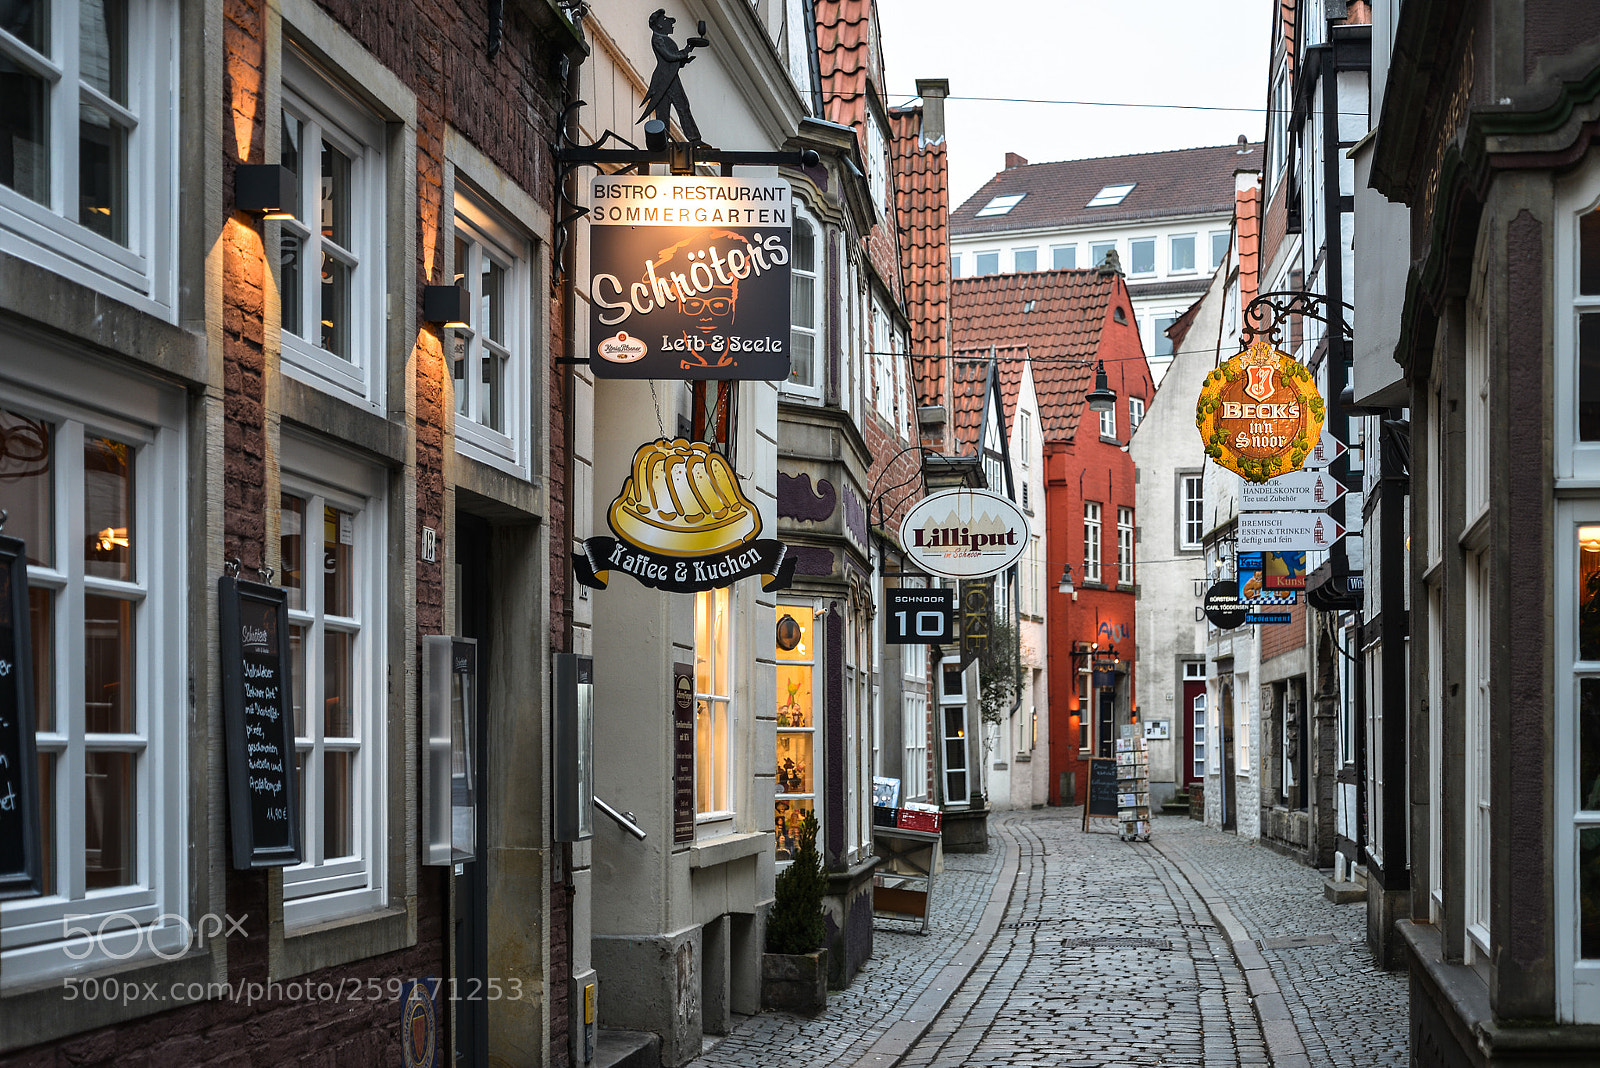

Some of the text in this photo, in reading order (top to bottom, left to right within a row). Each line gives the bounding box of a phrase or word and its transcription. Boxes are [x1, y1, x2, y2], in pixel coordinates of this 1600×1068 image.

[594, 184, 786, 201] BISTRO RESTAURANT
[593, 206, 786, 223] SOMMERGARTEN
[591, 232, 789, 325] Schröter's
[661, 335, 782, 353] Leib & Seele
[1235, 431, 1287, 448] Snoor
[1243, 487, 1310, 495] HANDELSKONTOR
[913, 527, 1018, 551] Lilliput
[1276, 527, 1311, 535] TRINKEN
[1241, 536, 1263, 545] deftig
[1278, 535, 1292, 543] fein
[607, 543, 763, 582] Kaffee & Kuchen
[895, 611, 945, 636] 10
[1246, 614, 1290, 623] Restaurant
